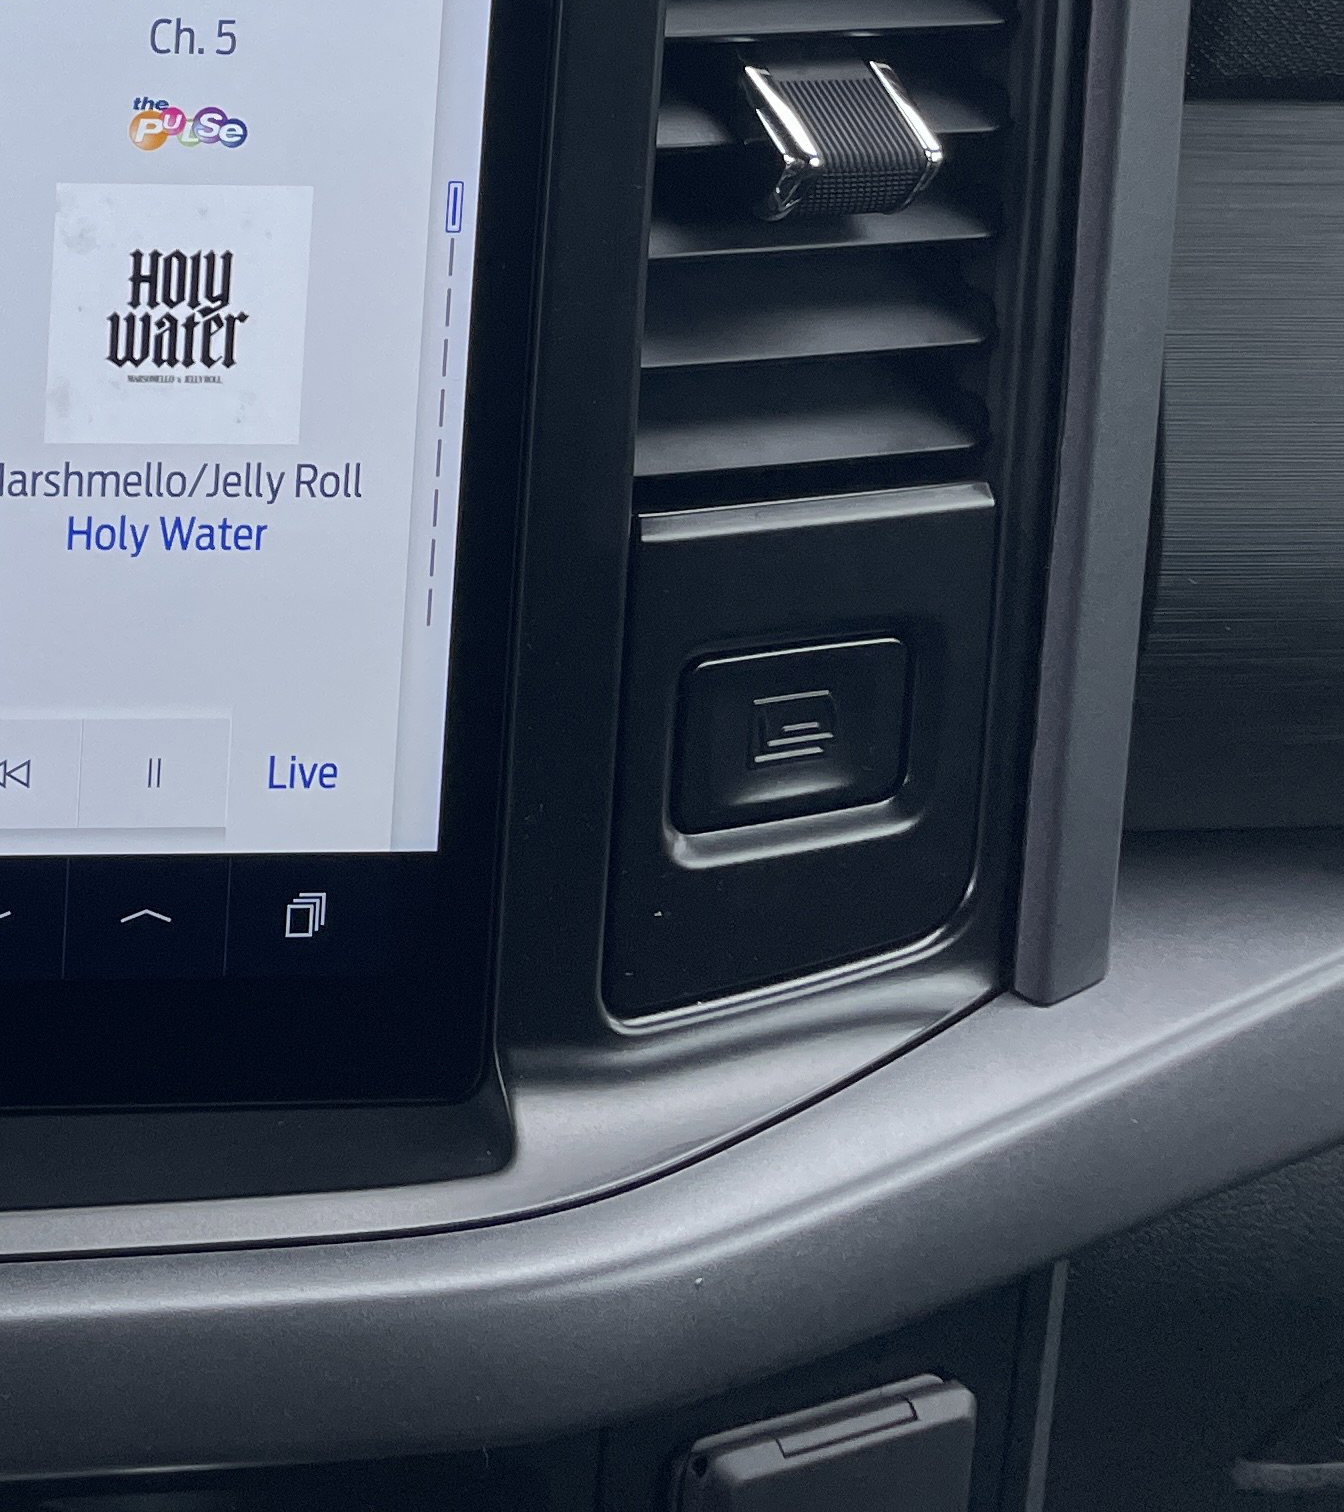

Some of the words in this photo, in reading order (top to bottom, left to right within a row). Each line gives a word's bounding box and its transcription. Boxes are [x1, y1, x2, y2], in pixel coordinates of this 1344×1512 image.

[150, 17, 205, 55] Ch.
[215, 19, 237, 56] 5
[132, 96, 170, 110] the
[295, 462, 362, 498] Roll
[67, 514, 150, 558] Holy
[159, 516, 268, 551] Water
[268, 755, 338, 789] Live
